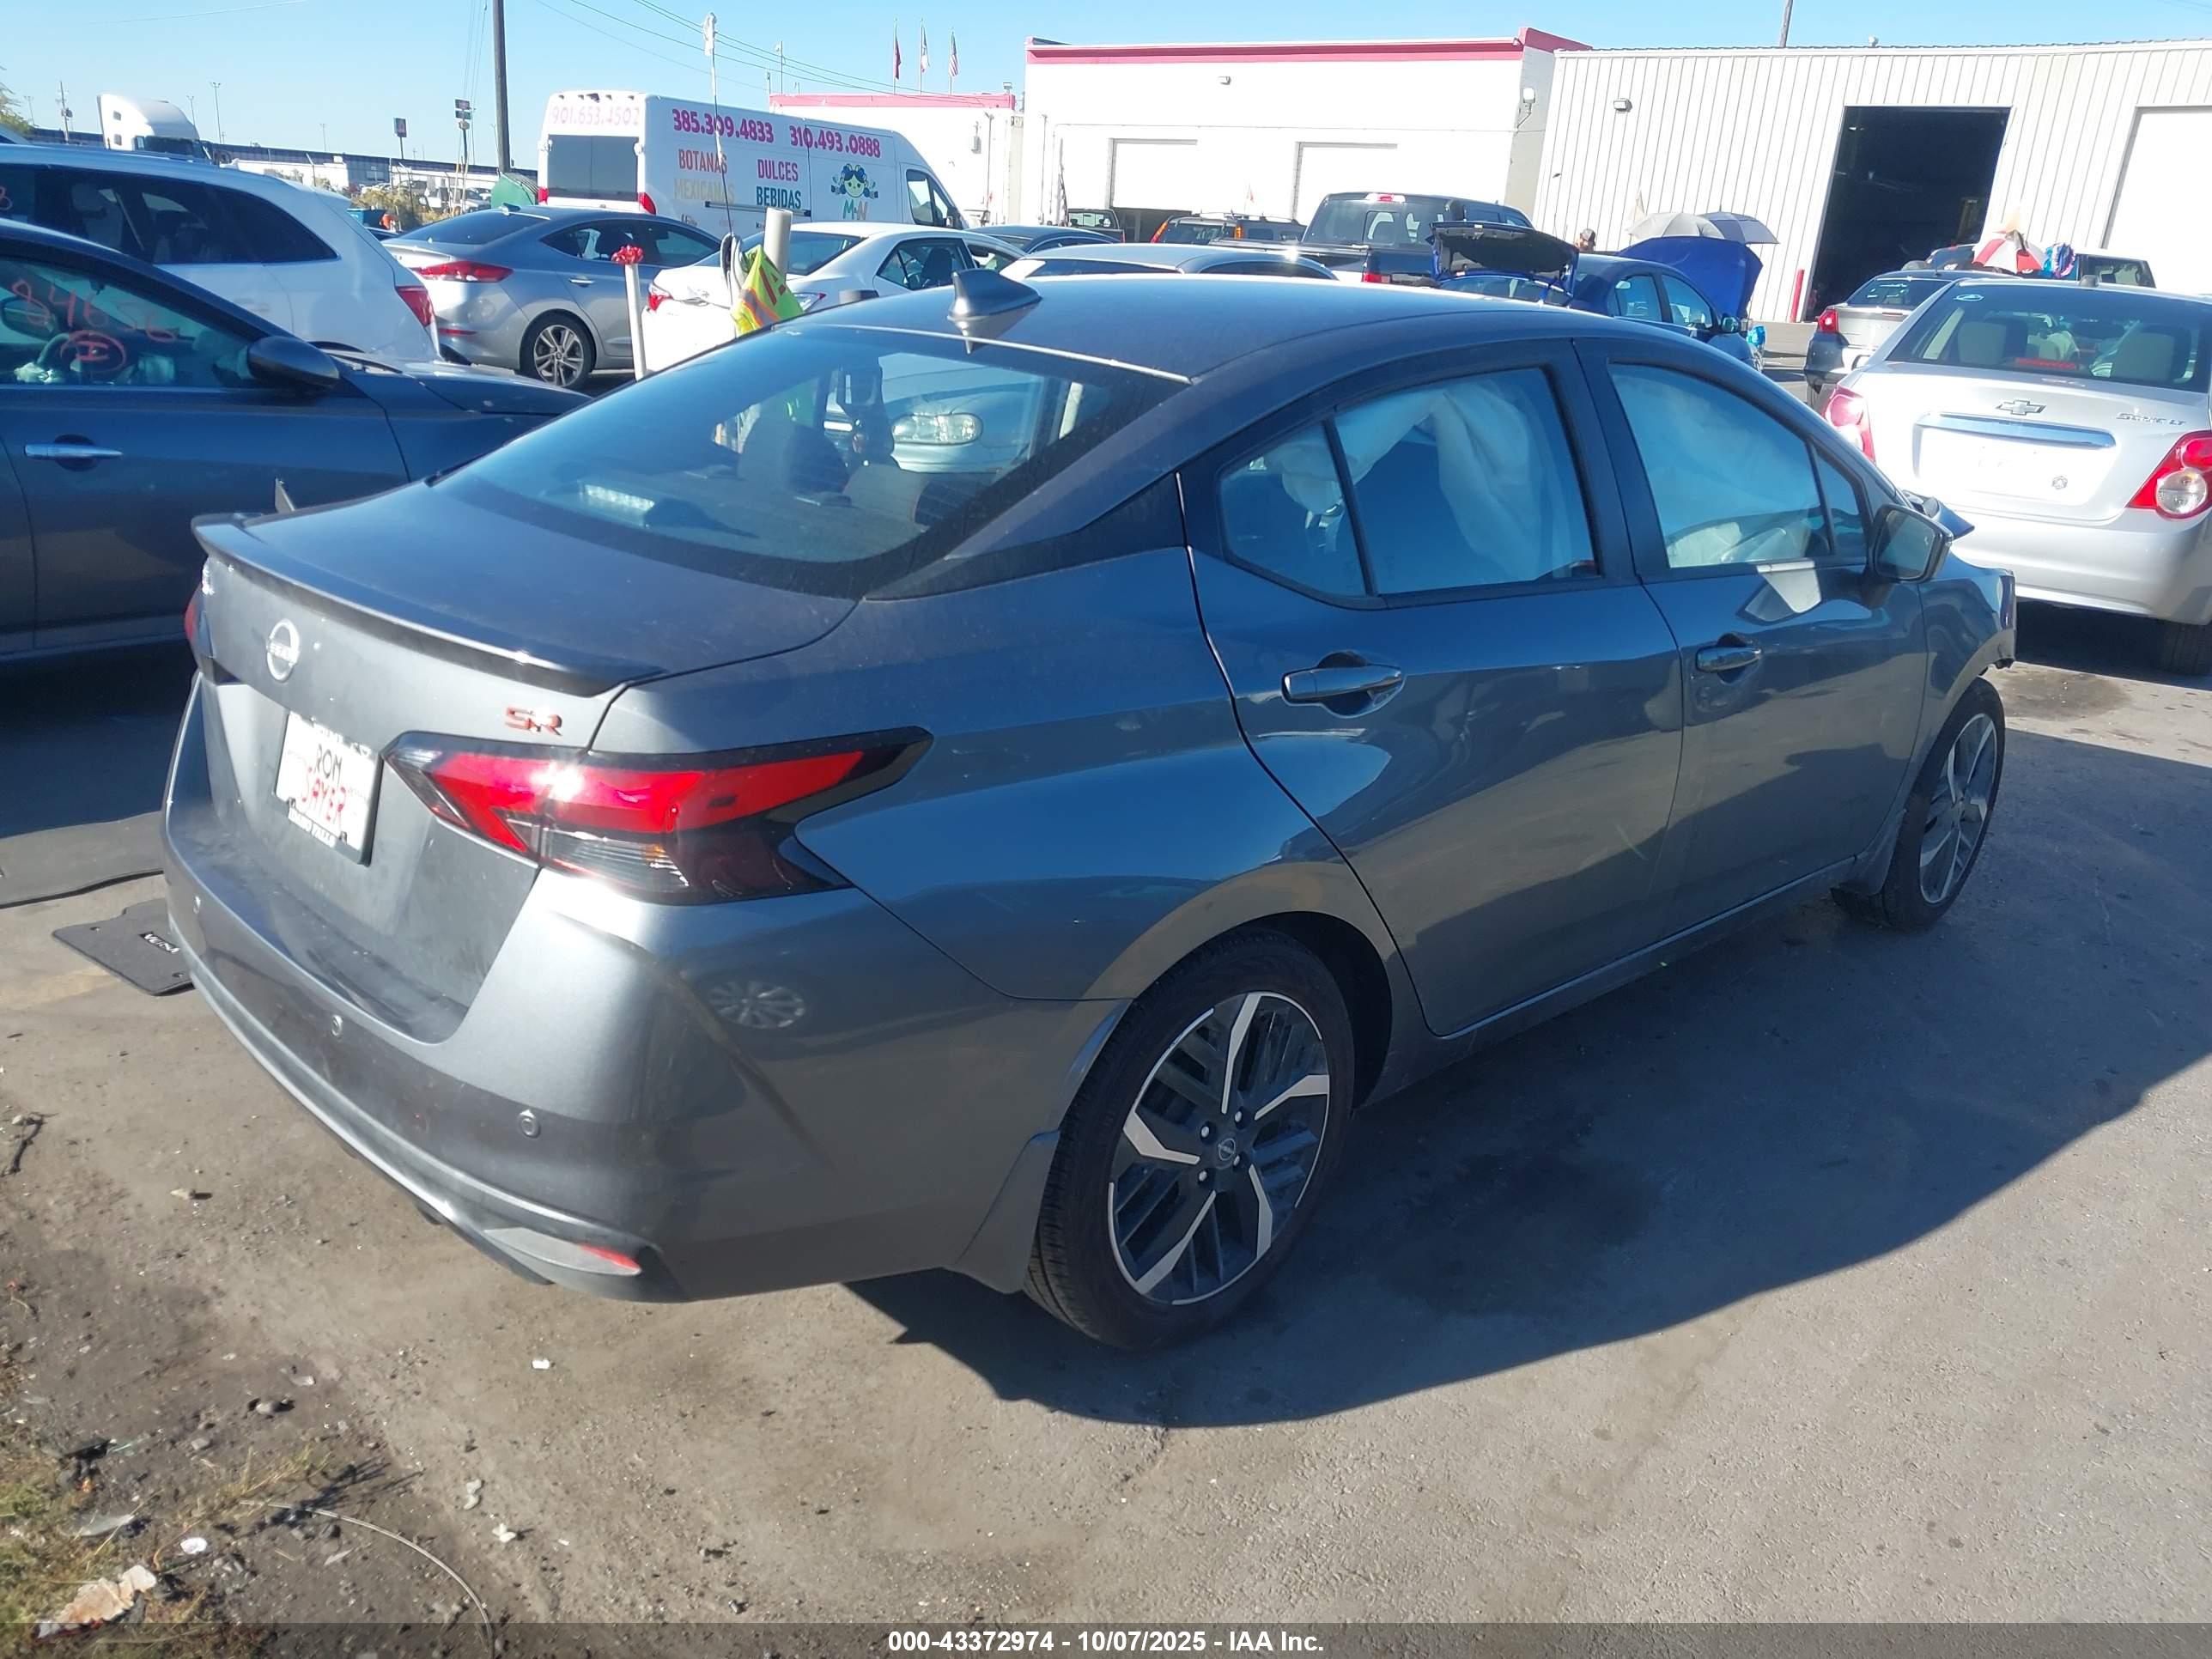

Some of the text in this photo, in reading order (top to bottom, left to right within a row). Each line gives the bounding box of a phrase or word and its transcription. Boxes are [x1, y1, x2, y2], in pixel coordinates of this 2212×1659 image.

[672, 108, 881, 158] 385.309.4833 310.493.0888
[678, 149, 728, 173] BOTANAS
[757, 158, 799, 182] DULCES
[756, 185, 802, 210] BEBIDAS
[504, 706, 563, 737] SR
